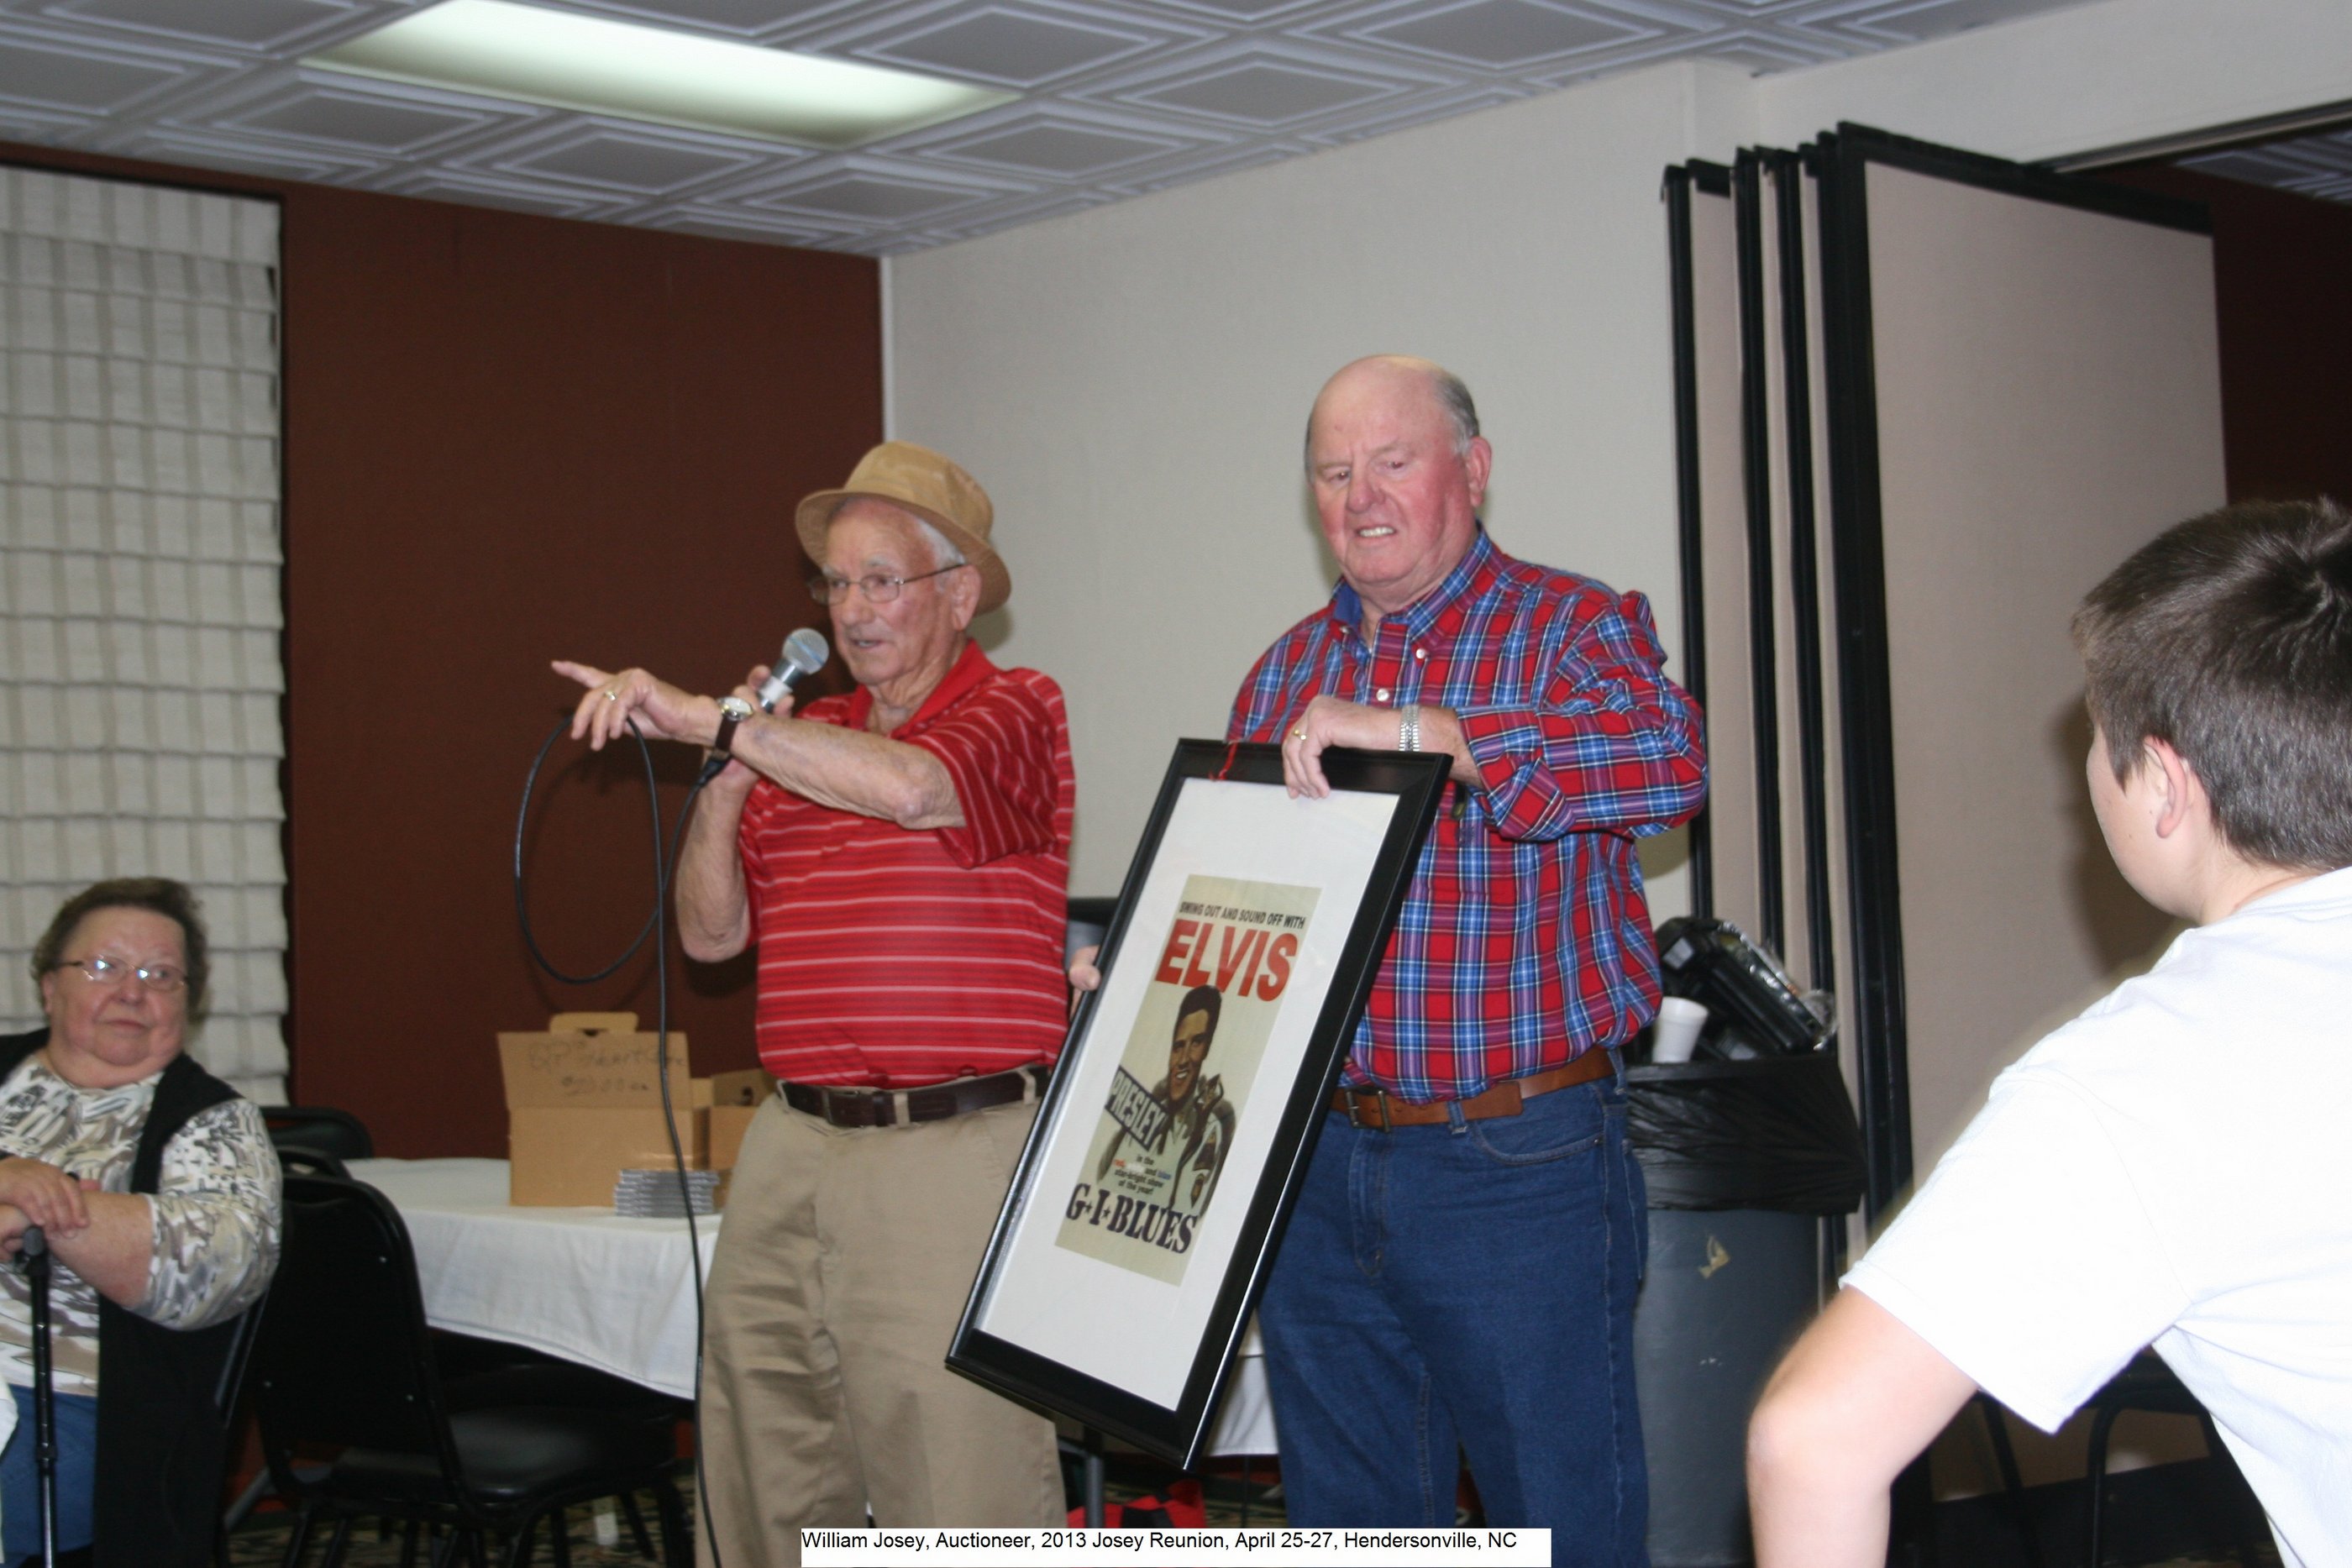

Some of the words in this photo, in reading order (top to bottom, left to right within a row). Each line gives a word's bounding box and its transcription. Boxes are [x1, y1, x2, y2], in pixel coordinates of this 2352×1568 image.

[1179, 902, 1205, 915] SWING
[1204, 905, 1222, 918] OUT
[1221, 907, 1239, 920] AND
[1238, 910, 1267, 924] SOUND
[1267, 913, 1284, 926] OFF
[1284, 915, 1306, 930] WITH
[1154, 918, 1298, 1002] ELVIS
[1110, 1070, 1166, 1145] PRESLEY
